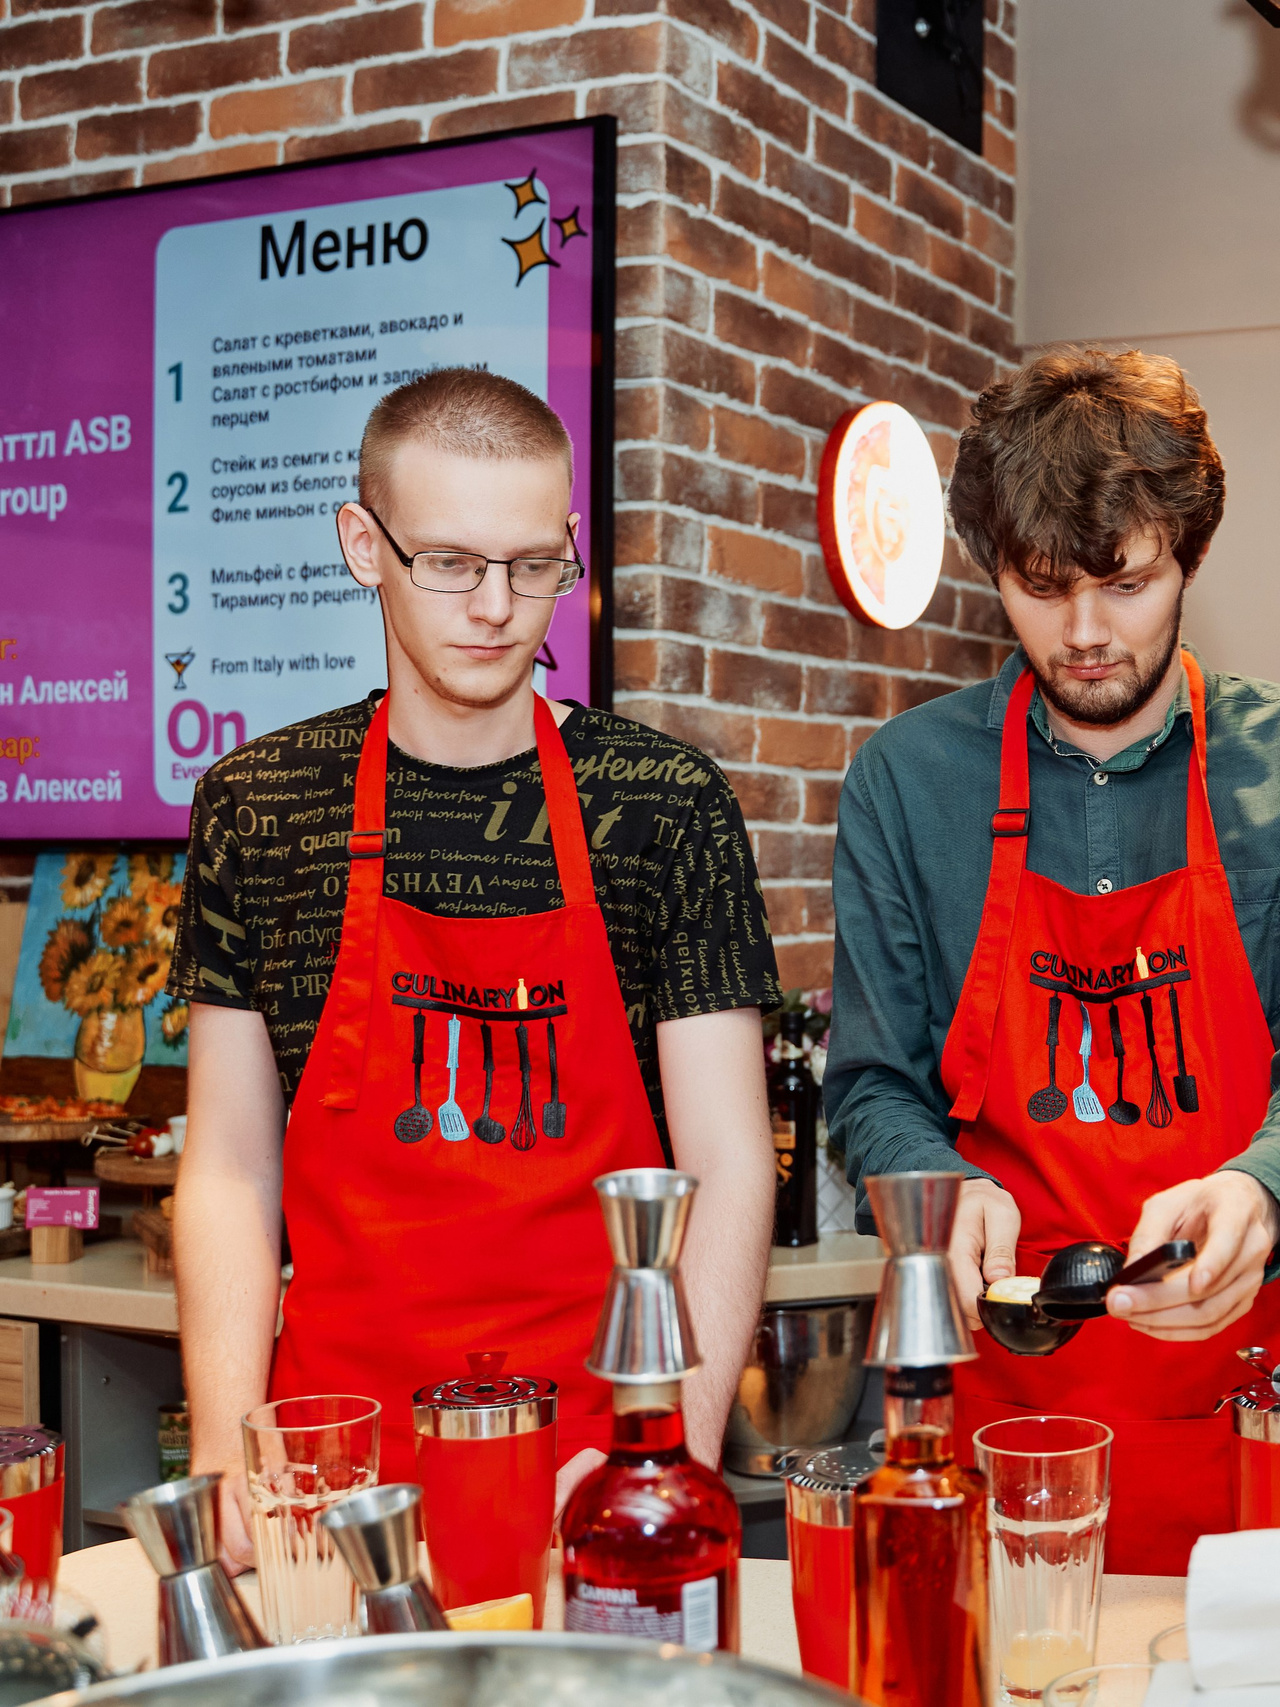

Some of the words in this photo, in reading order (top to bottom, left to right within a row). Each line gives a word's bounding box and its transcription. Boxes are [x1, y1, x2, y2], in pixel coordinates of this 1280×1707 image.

[260, 217, 430, 281] Меню
[213, 336, 258, 354] Салат
[262, 335, 271, 347] с
[275, 324, 374, 350] креветками,
[379, 313, 449, 335] авокадо
[453, 312, 463, 326] и
[213, 359, 293, 379] вялеными
[297, 347, 377, 369] томатами
[166, 362, 183, 402] 1
[213, 386, 257, 403] Салат
[262, 385, 271, 398] с
[274, 372, 364, 400] ростбифом
[368, 372, 378, 386] и
[212, 408, 270, 429] перцем
[64, 414, 132, 457] ASB
[211, 456, 257, 475] Стейк
[261, 456, 278, 470] из
[283, 451, 330, 468] семги
[334, 450, 343, 463] с
[0, 483, 68, 522] roup
[166, 470, 190, 514] 2
[211, 482, 266, 503] соусом
[270, 480, 288, 494] из
[293, 473, 347, 493] белого
[211, 506, 251, 524] Филе
[256, 501, 314, 520] миньон
[319, 501, 328, 515] с
[211, 564, 283, 585] Мильфей
[287, 567, 296, 580] с
[167, 571, 190, 615] 3
[211, 592, 286, 612] Тирамису
[290, 591, 309, 605] по
[313, 585, 379, 607] рецепту
[211, 657, 249, 675] From
[253, 655, 284, 677] Italy
[288, 654, 320, 671] with
[324, 652, 356, 670] love
[19, 669, 129, 705] Алексей
[167, 699, 247, 759] On
[14, 769, 123, 803] Алексей
[235, 804, 281, 838] On
[503, 852, 555, 868] Friend
[488, 875, 539, 890] Angel
